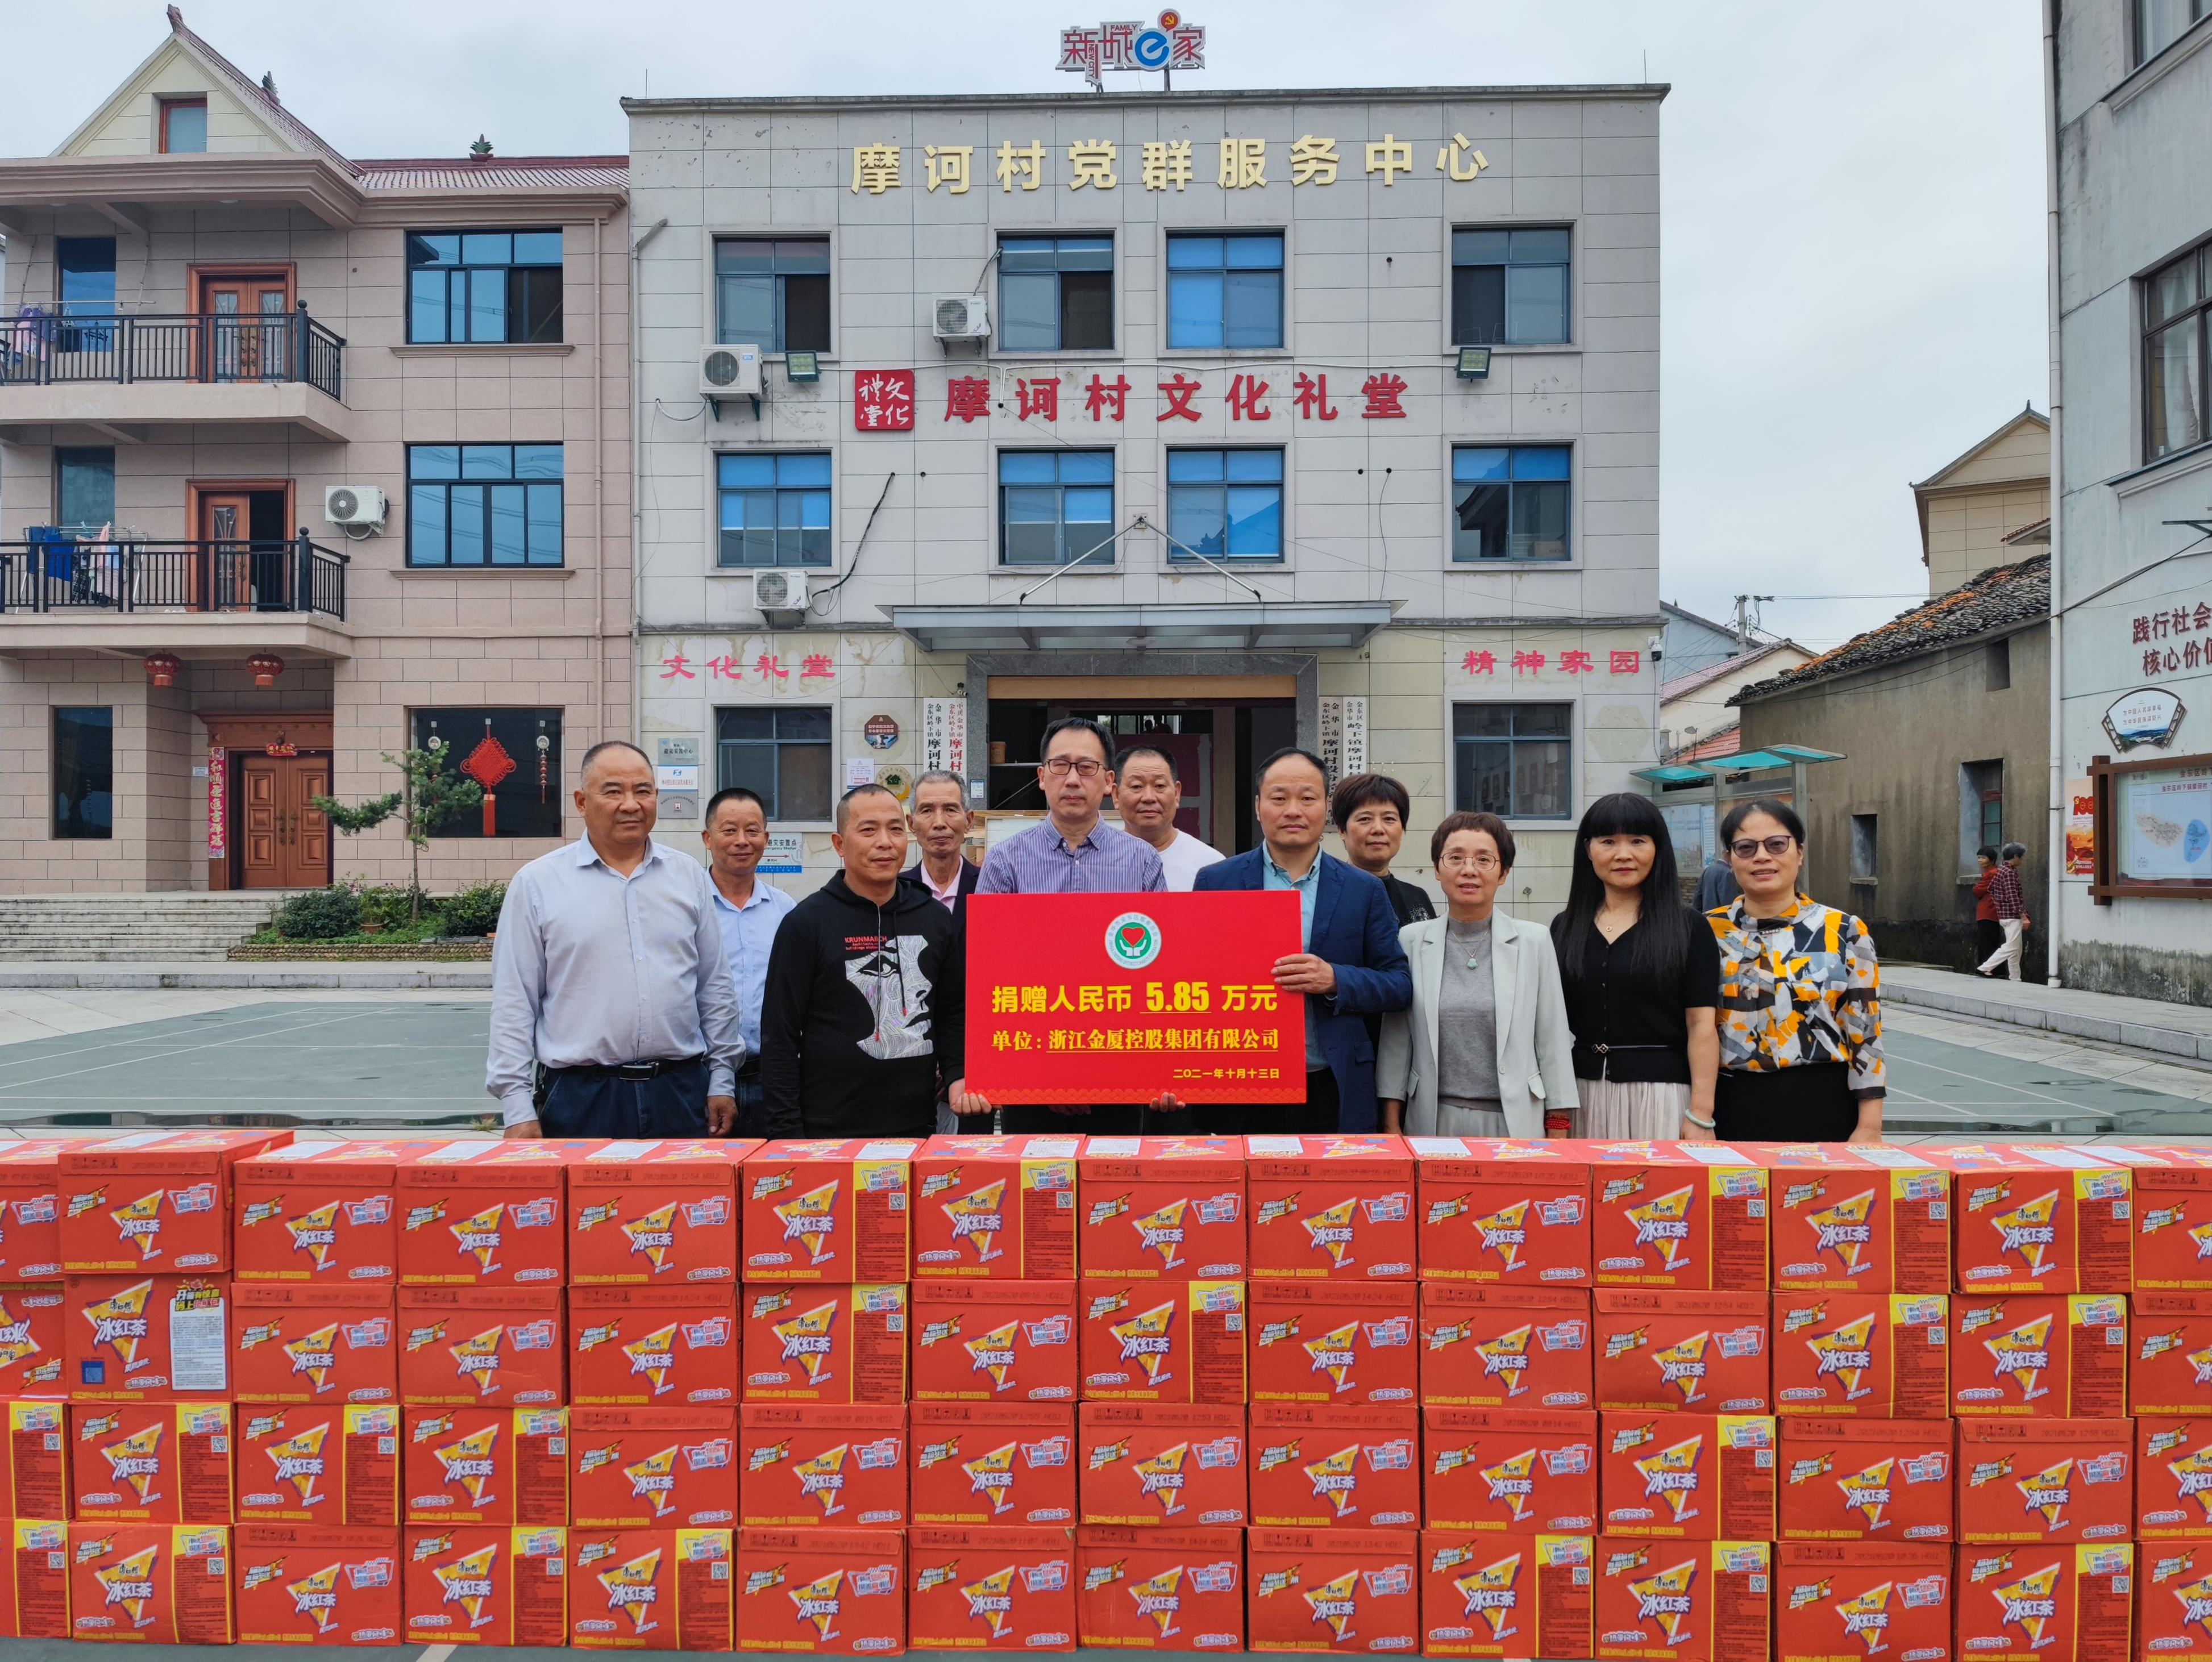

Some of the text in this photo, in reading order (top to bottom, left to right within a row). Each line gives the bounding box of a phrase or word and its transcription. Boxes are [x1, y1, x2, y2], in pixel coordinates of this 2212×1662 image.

[850, 132, 1489, 193] 摩诃村党群服务中心
[944, 372, 1409, 422] 摩诃村文化礼堂
[2132, 601, 2212, 644] 践行社会
[659, 653, 837, 680] 文化礼堂
[1461, 649, 1640, 676] 精神家园
[2123, 705, 2162, 716] 为中国人民谋幸福
[2123, 715, 2162, 726] 为中华民族谋复兴
[991, 981, 1279, 1014] 捐赠人民币 5.85 万元
[120, 1219, 160, 1240] 冰红茶
[785, 1215, 833, 1240] 冰红茶
[953, 1214, 1001, 1238] 冰红茶
[1637, 1220, 1688, 1247] 冰红茶
[294, 1230, 335, 1251] 冰红茶
[459, 1233, 500, 1254] 冰红茶
[632, 1232, 672, 1253] 冰红茶
[1143, 1228, 1183, 1249] 冰红茶
[1312, 1227, 1353, 1248] 冰红茶
[1482, 1229, 1524, 1251] 冰红茶
[1818, 1224, 1869, 1251] 冰红茶
[2002, 1226, 2053, 1253] 冰红茶
[94, 1318, 147, 1345] 冰红茶
[783, 1336, 831, 1360] 冰红茶
[1121, 1336, 1170, 1361] 冰红茶
[293, 1353, 334, 1374] 冰红茶
[459, 1355, 499, 1376] 冰红茶
[632, 1353, 672, 1374] 冰红茶
[974, 1351, 1014, 1372] 冰红茶
[1312, 1351, 1354, 1372] 冰红茶
[1485, 1354, 1527, 1376] 冰红茶
[1819, 1349, 1870, 1376] 冰红茶
[1996, 1350, 2047, 1377] 冰红茶
[1662, 1362, 1704, 1384] 冰红茶
[112, 1457, 159, 1481] 冰红茶
[276, 1457, 324, 1482] 冰红茶
[446, 1459, 493, 1484] 冰红茶
[633, 1476, 673, 1497] 冰红茶
[803, 1474, 843, 1495] 冰红茶
[972, 1472, 1013, 1493] 冰红茶
[1143, 1473, 1183, 1494] 冰红茶
[1313, 1474, 1356, 1496] 冰红茶
[1490, 1478, 1532, 1500] 冰红茶
[1646, 1471, 1697, 1498] 冰红茶
[2180, 1474, 2212, 1499] 冰红
[1847, 1488, 1889, 1510] 冰红茶
[2026, 1489, 2068, 1511] 冰红茶
[105, 1581, 152, 1605] 冰红茶
[444, 1579, 492, 1603] 冰红茶
[609, 1585, 656, 1609] 冰红茶
[296, 1593, 336, 1614] 冰红茶
[799, 1599, 839, 1621] 冰红茶
[970, 1596, 1011, 1617] 冰红茶
[1137, 1596, 1179, 1617] 冰红茶
[1313, 1601, 1355, 1622] 冰红茶
[1466, 1590, 1515, 1615] 冰红茶
[1639, 1594, 1690, 1621] 冰红茶
[2005, 1599, 2054, 1624] 冰红茶
[1845, 1613, 1887, 1635] 冰红茶
